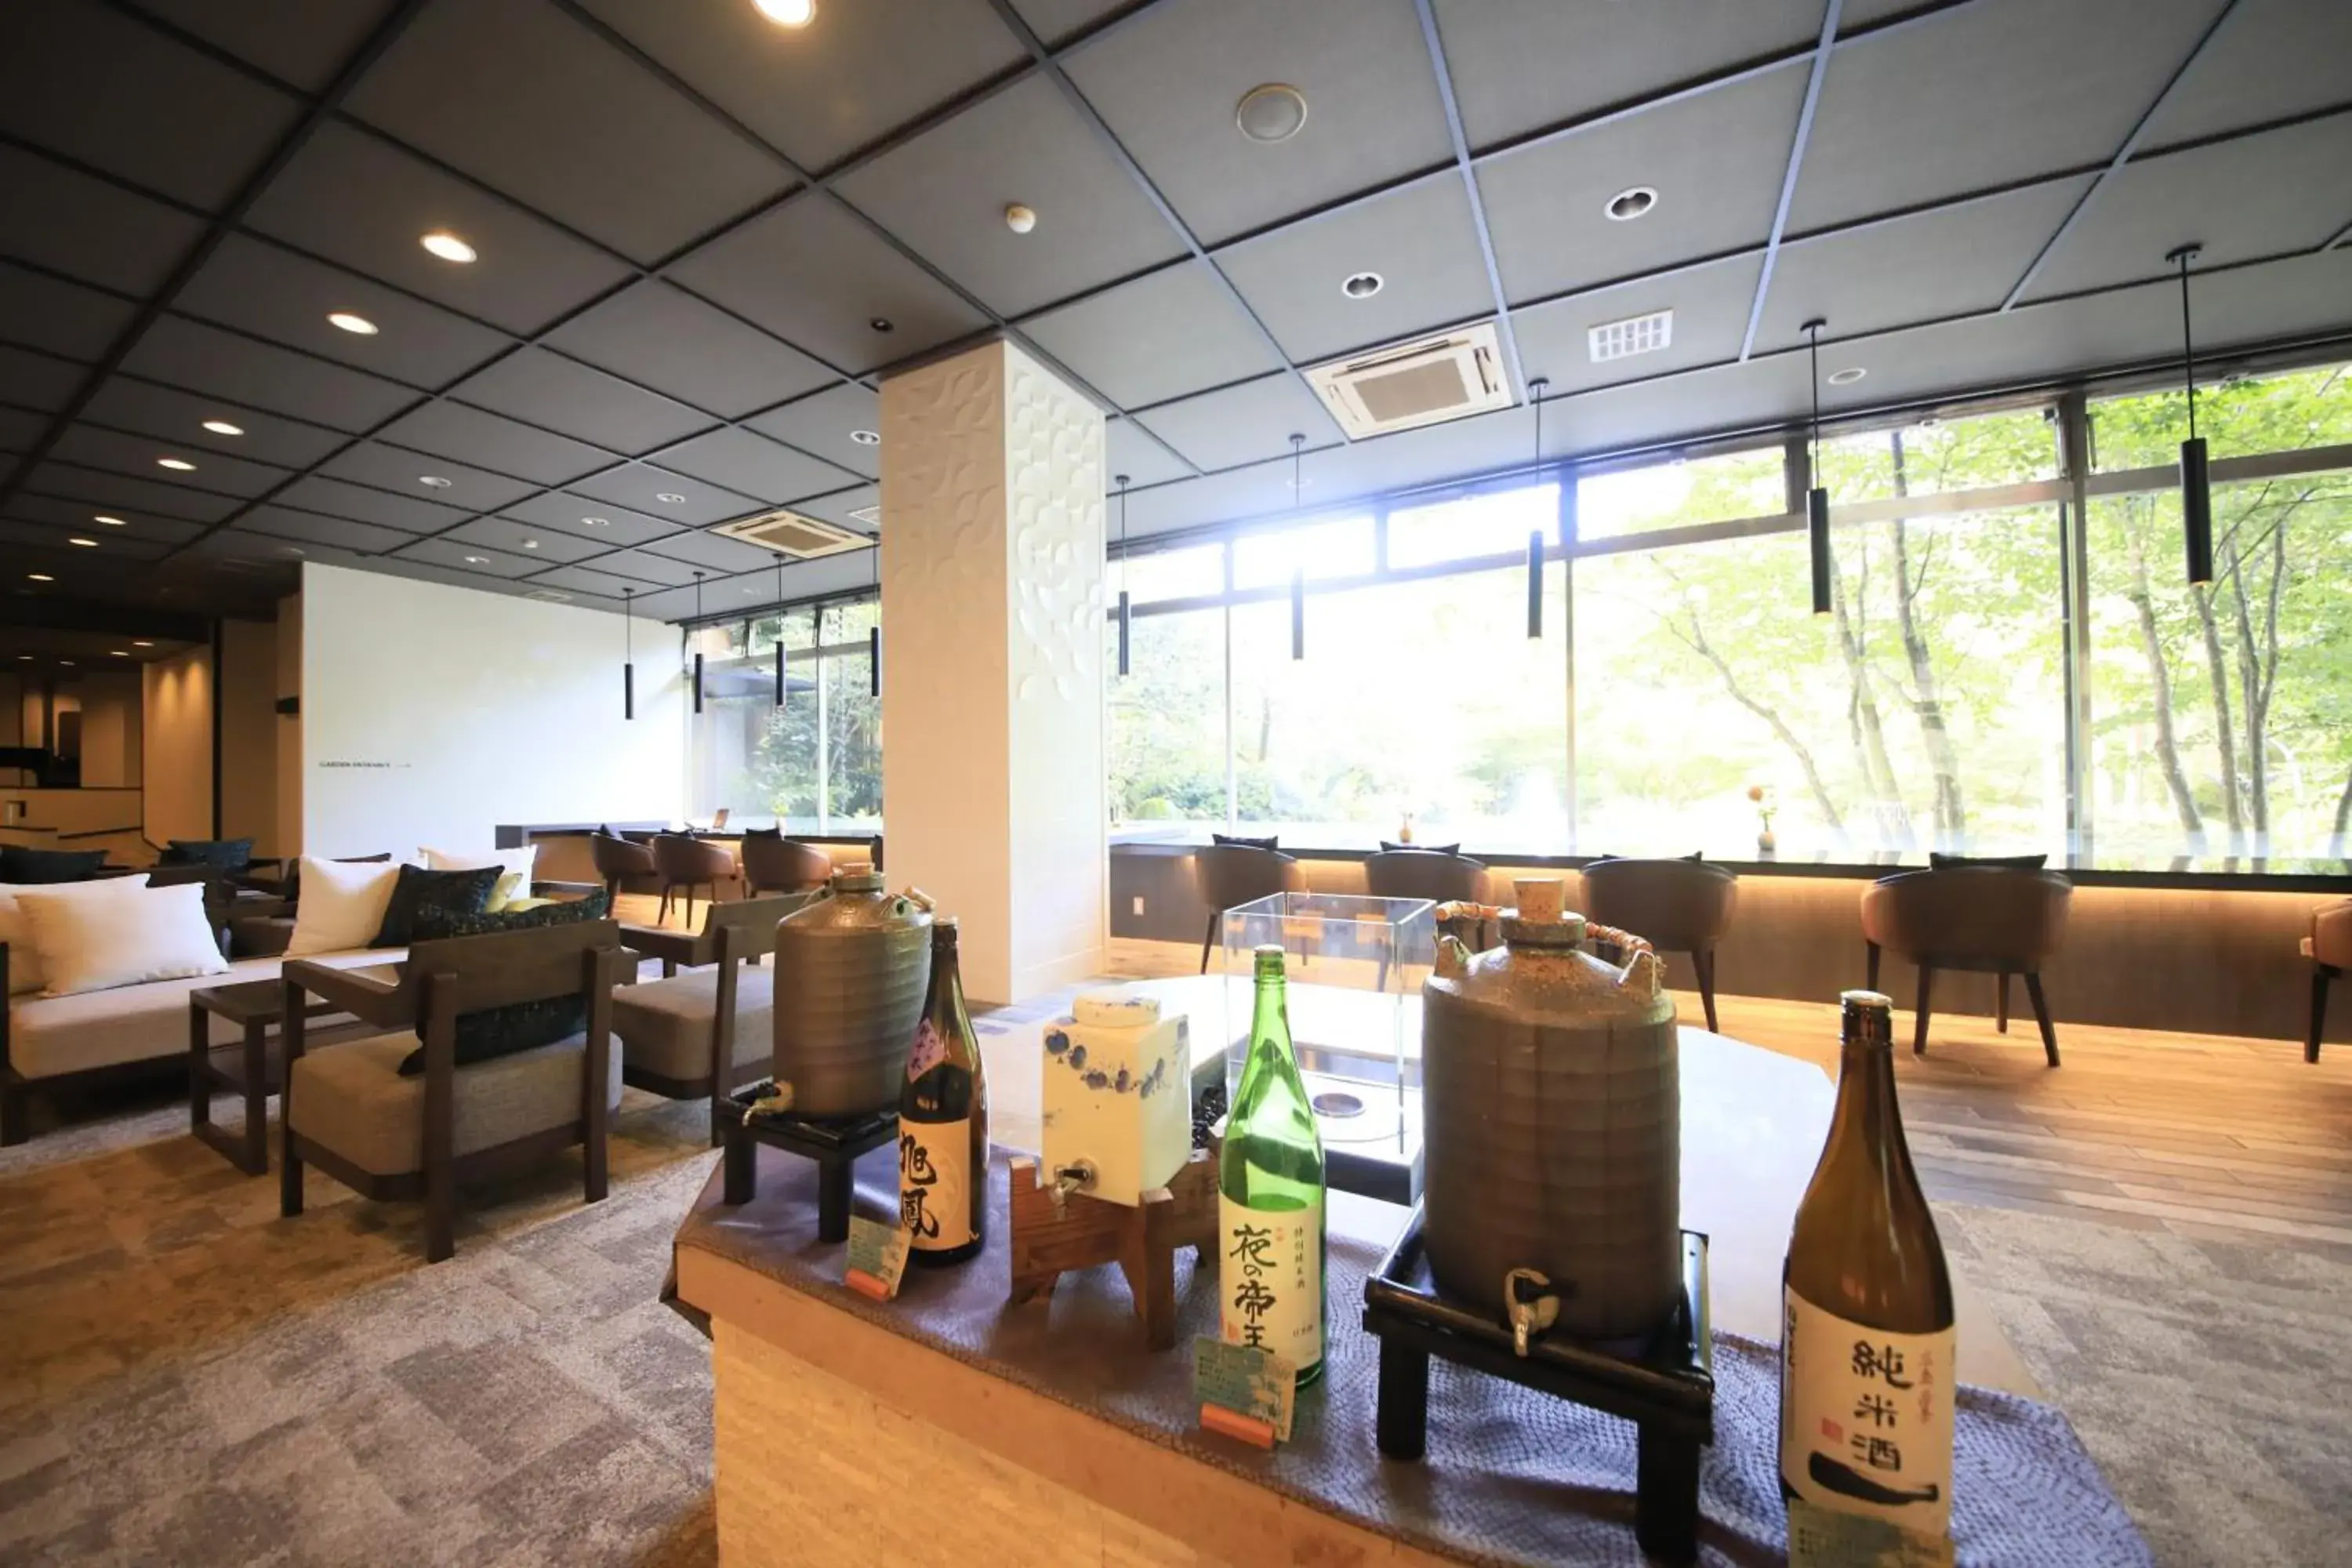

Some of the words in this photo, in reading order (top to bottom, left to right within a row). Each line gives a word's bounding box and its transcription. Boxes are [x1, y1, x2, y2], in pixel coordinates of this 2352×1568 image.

[899, 1131, 939, 1240] 旭鳳
[1229, 1222, 1277, 1355] 夜の帝王
[1850, 1339, 1915, 1472] 純米酒
